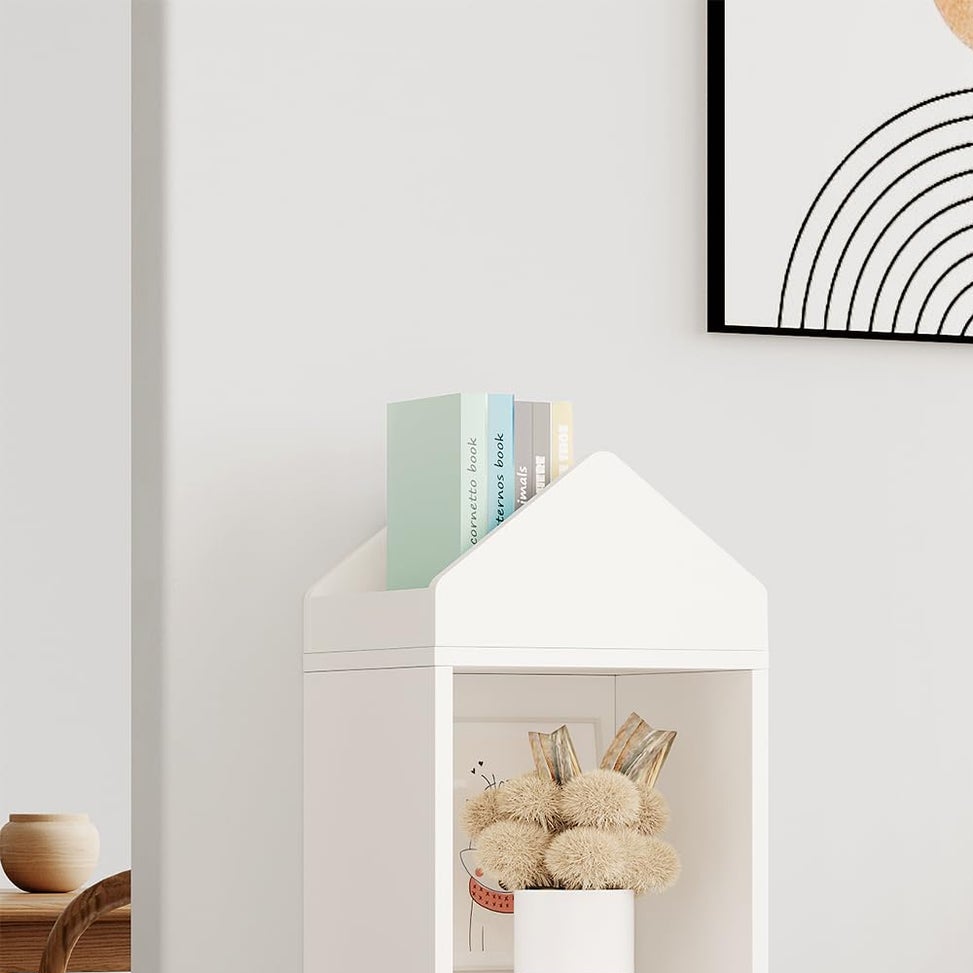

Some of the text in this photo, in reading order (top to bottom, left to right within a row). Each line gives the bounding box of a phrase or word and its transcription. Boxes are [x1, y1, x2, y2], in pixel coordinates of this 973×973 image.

[467, 437, 478, 545] cornetto book
[494, 433, 505, 526] ternos book
[517, 466, 528, 504] imals
